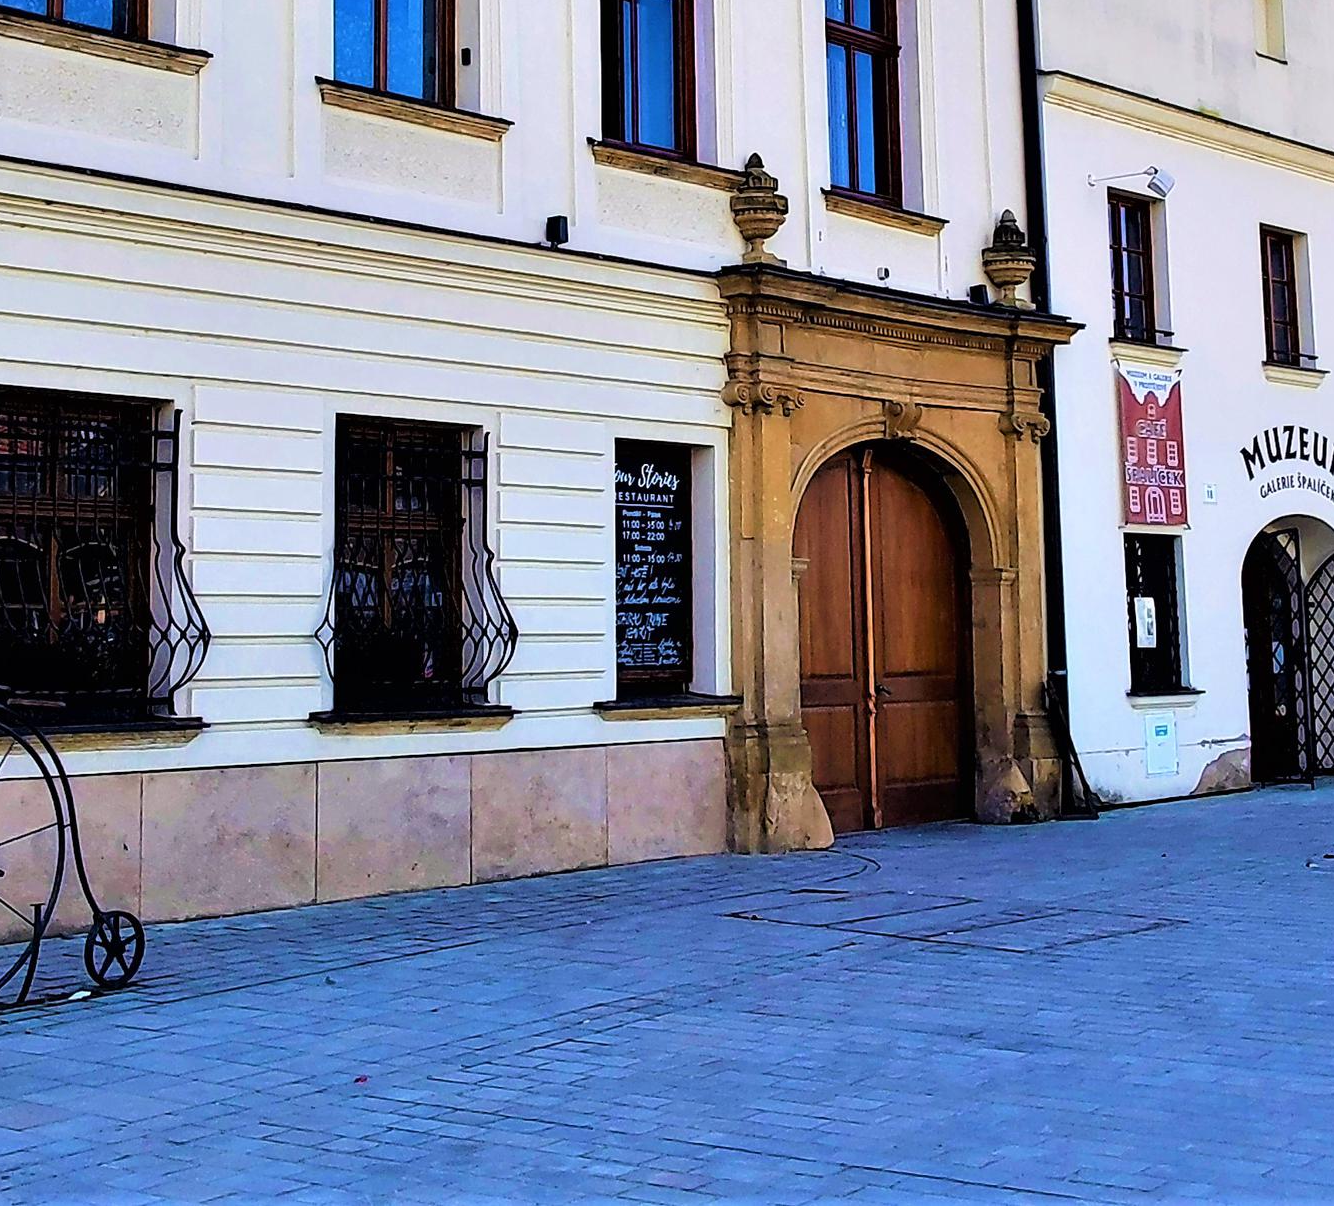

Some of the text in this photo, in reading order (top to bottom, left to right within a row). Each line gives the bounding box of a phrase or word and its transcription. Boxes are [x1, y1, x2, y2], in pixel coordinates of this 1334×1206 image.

[615, 462, 680, 491] our Stories
[1260, 475, 1295, 499] GALERIE
[616, 491, 674, 503] ESTAURANT
